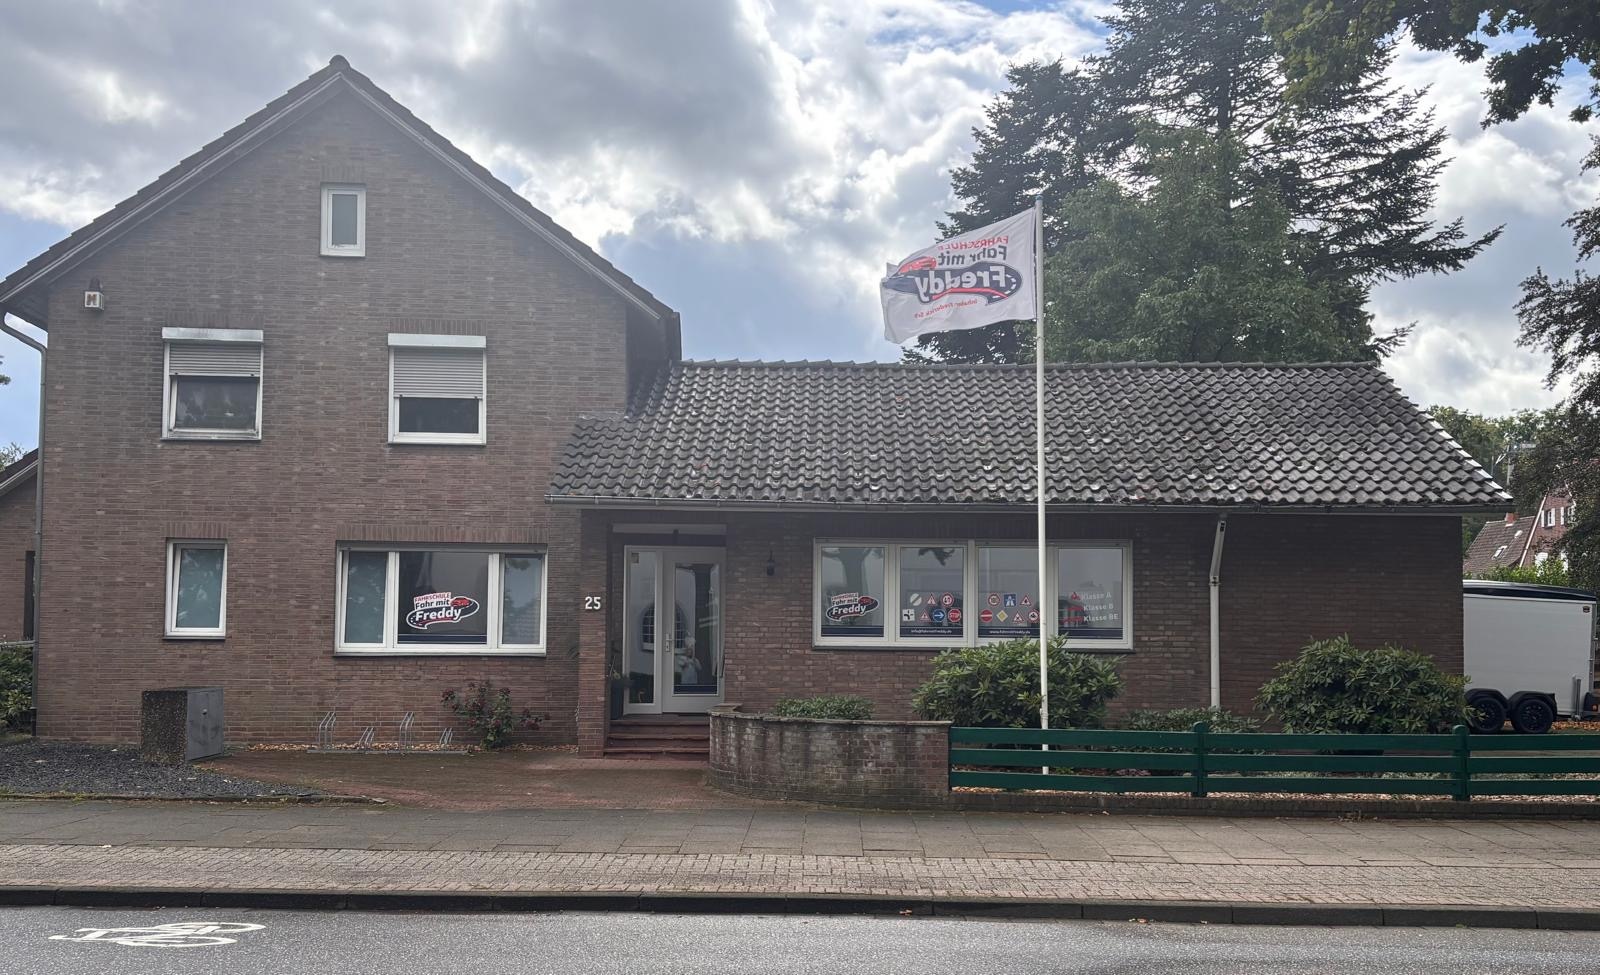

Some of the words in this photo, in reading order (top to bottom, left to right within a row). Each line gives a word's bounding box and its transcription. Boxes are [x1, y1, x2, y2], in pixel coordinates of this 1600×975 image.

[415, 593, 450, 603] FAHRSCHULE
[585, 596, 601, 610] 25
[415, 600, 433, 610] Fahr
[832, 604, 866, 615] Freddy
[415, 607, 462, 621] Freddy
[1083, 614, 1107, 622] Klasse
